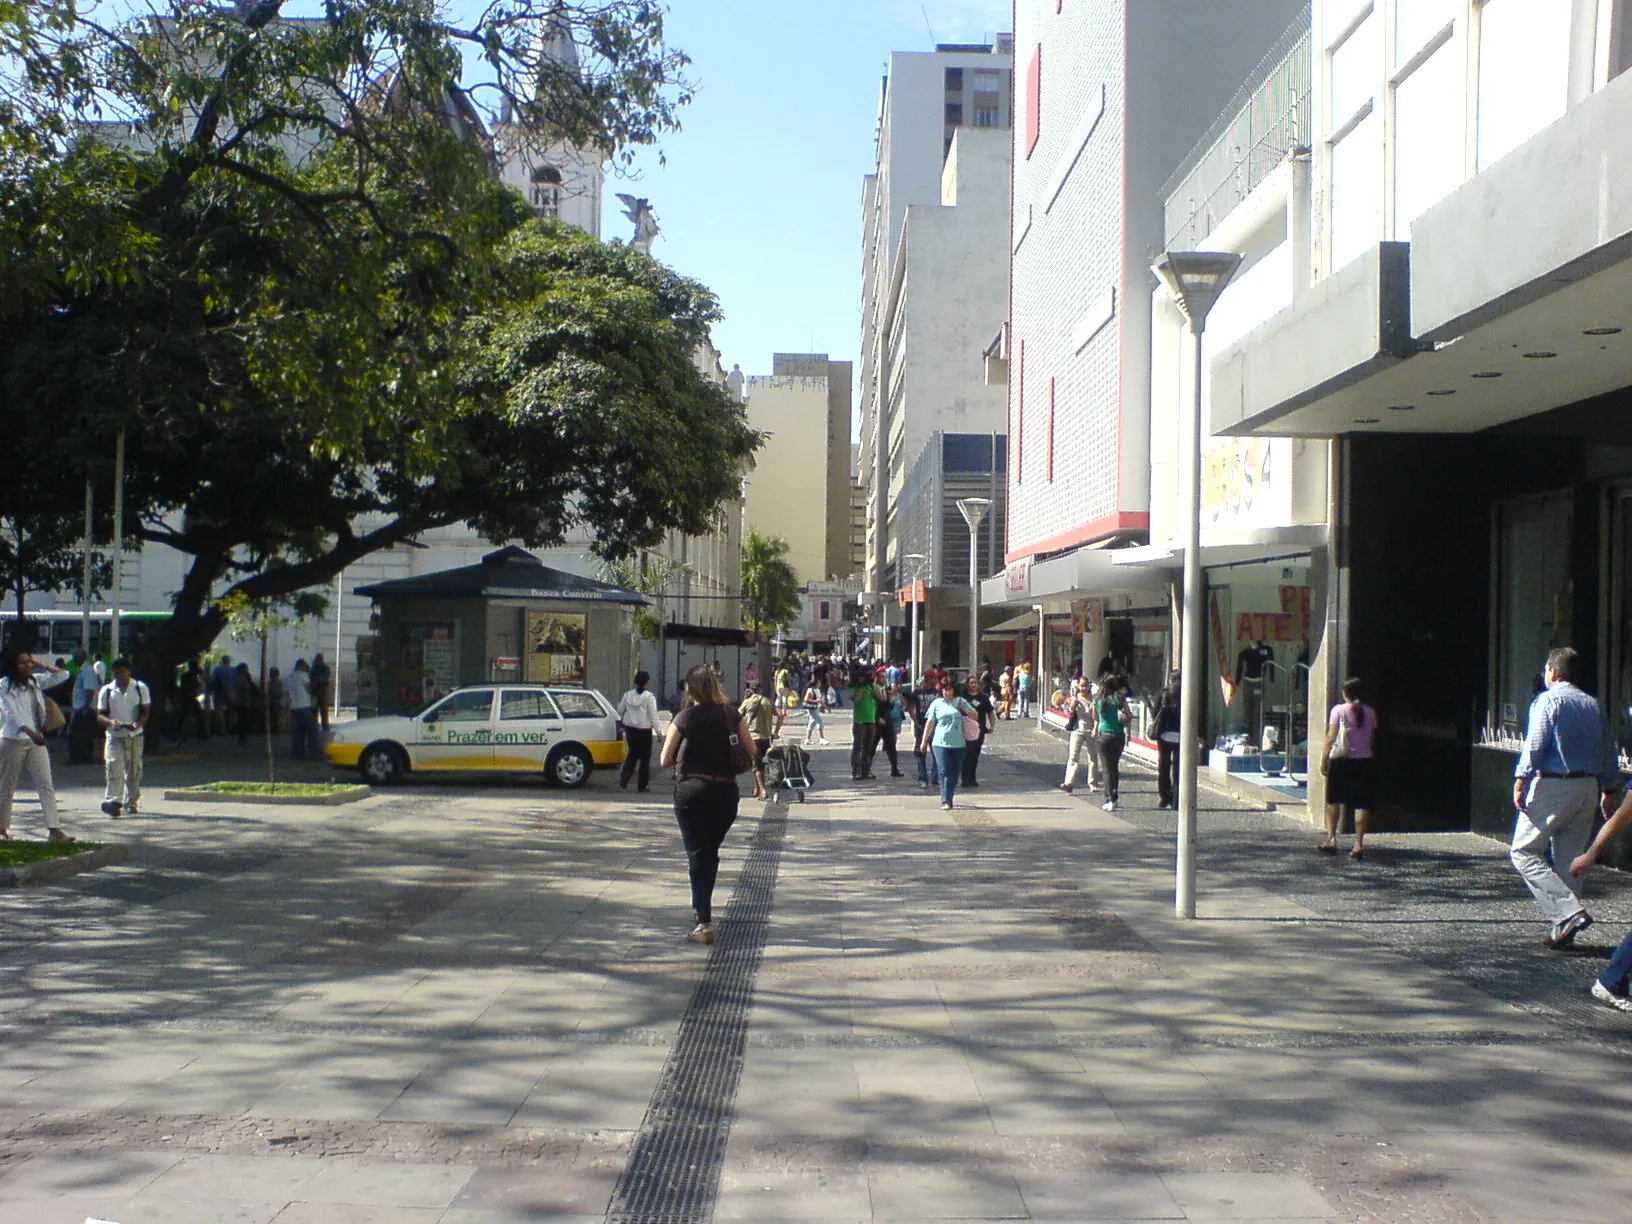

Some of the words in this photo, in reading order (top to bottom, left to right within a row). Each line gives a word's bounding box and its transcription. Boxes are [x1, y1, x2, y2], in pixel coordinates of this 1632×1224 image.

[531, 589, 560, 598] Banca
[562, 589, 603, 599] Convivio
[447, 730, 494, 743] Prazer
[495, 732, 519, 743] em
[521, 732, 548, 743] ver.
